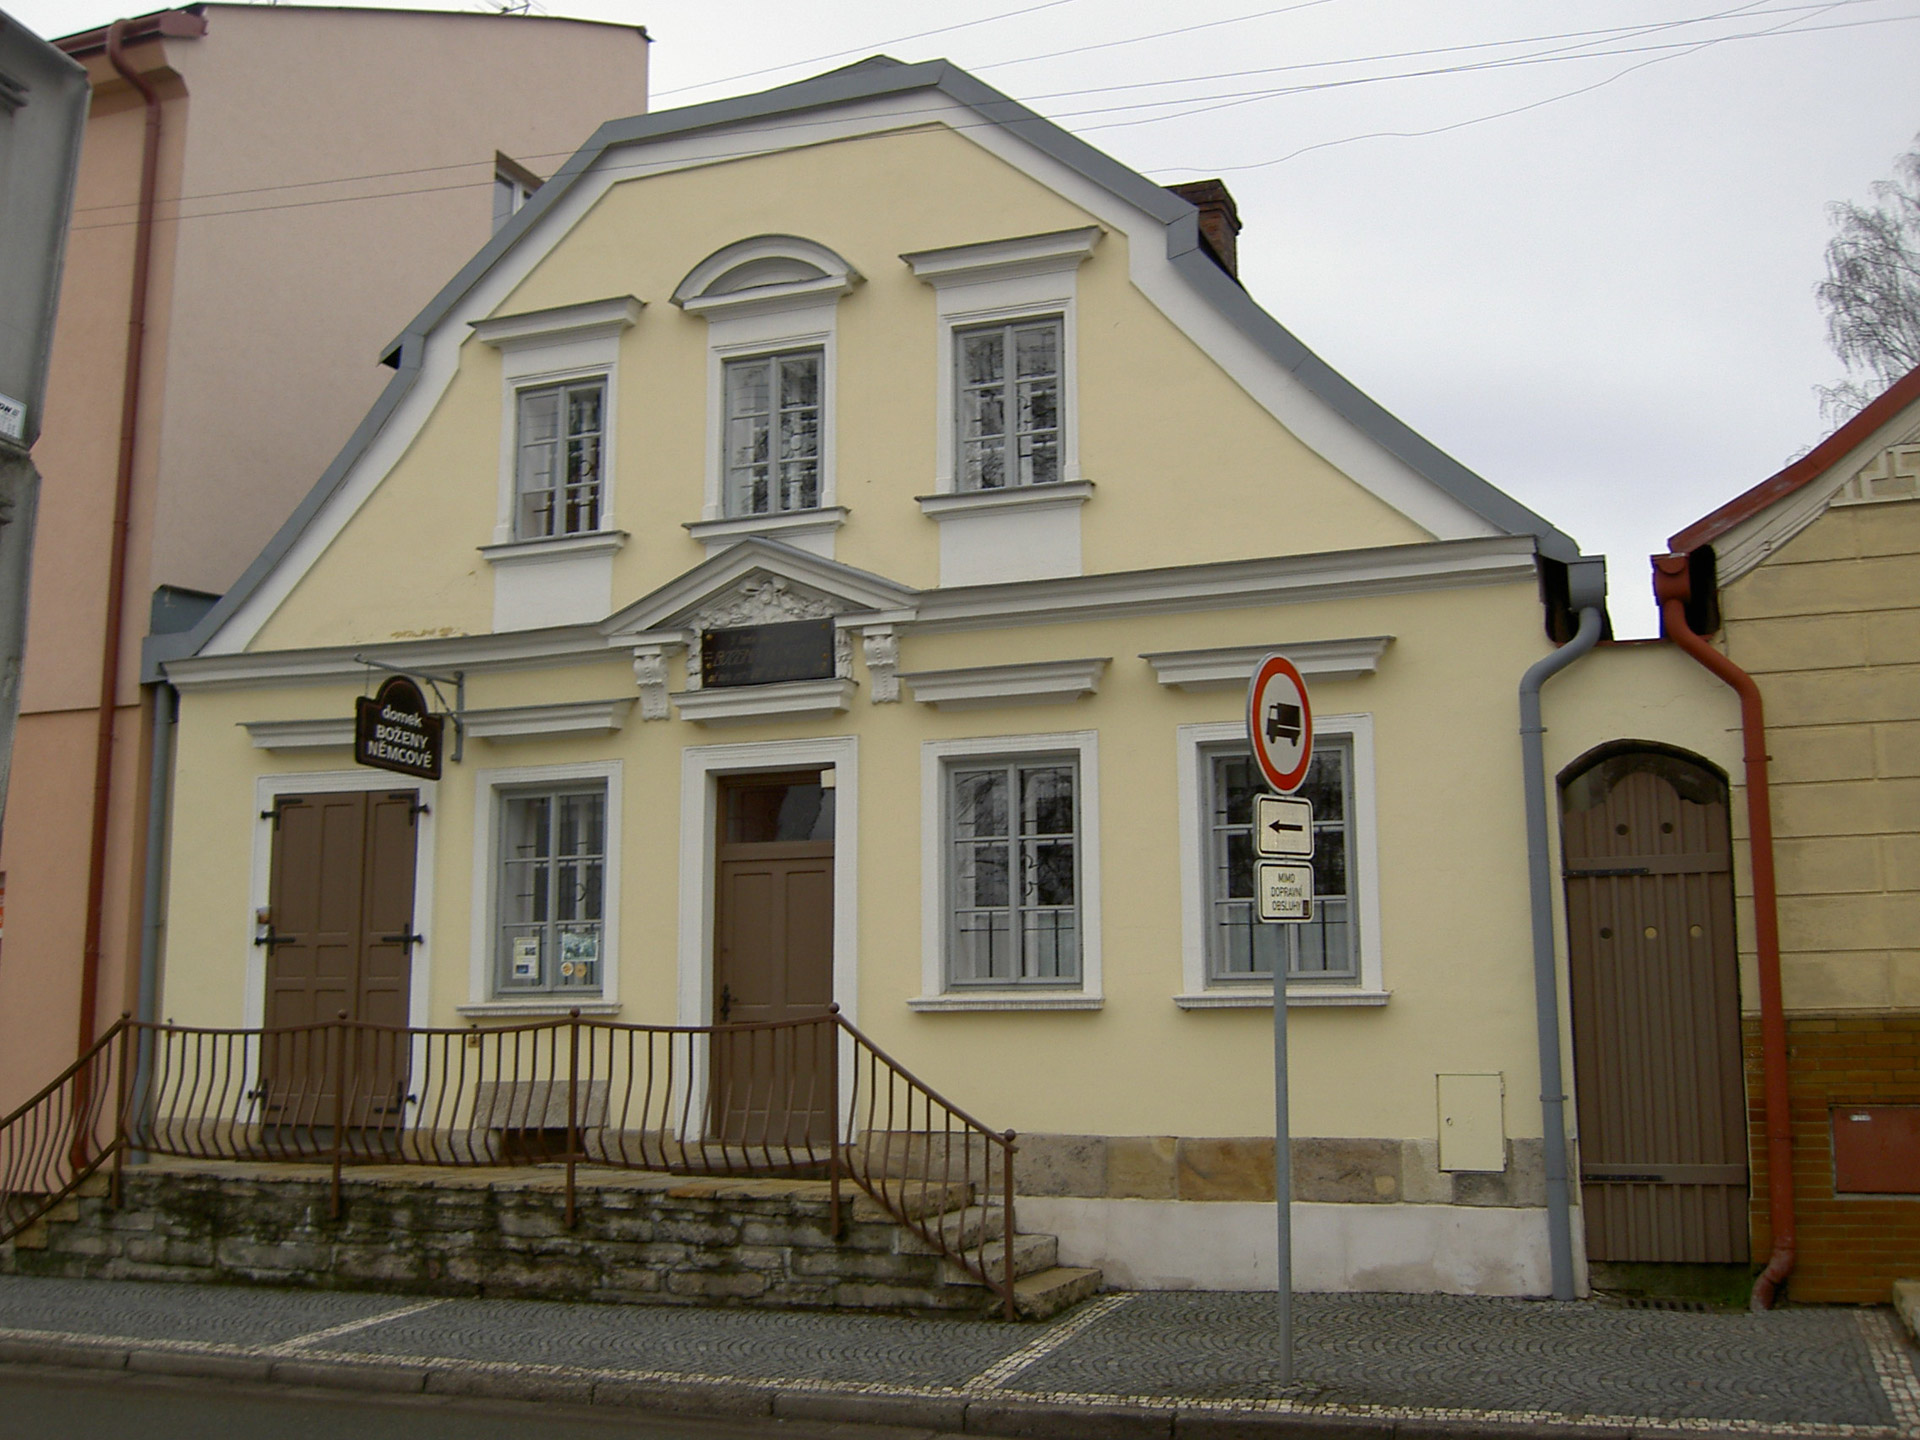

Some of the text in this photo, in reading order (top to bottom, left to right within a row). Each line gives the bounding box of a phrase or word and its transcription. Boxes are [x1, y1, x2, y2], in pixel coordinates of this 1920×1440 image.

[382, 704, 422, 727] domek
[376, 724, 428, 749] BOŽENY
[367, 740, 432, 768] NĚMCOVÉ
[1277, 872, 1296, 884] MIMO
[1270, 884, 1303, 898] DOPRAVNÍ
[1271, 900, 1301, 912] OBSLUHY
